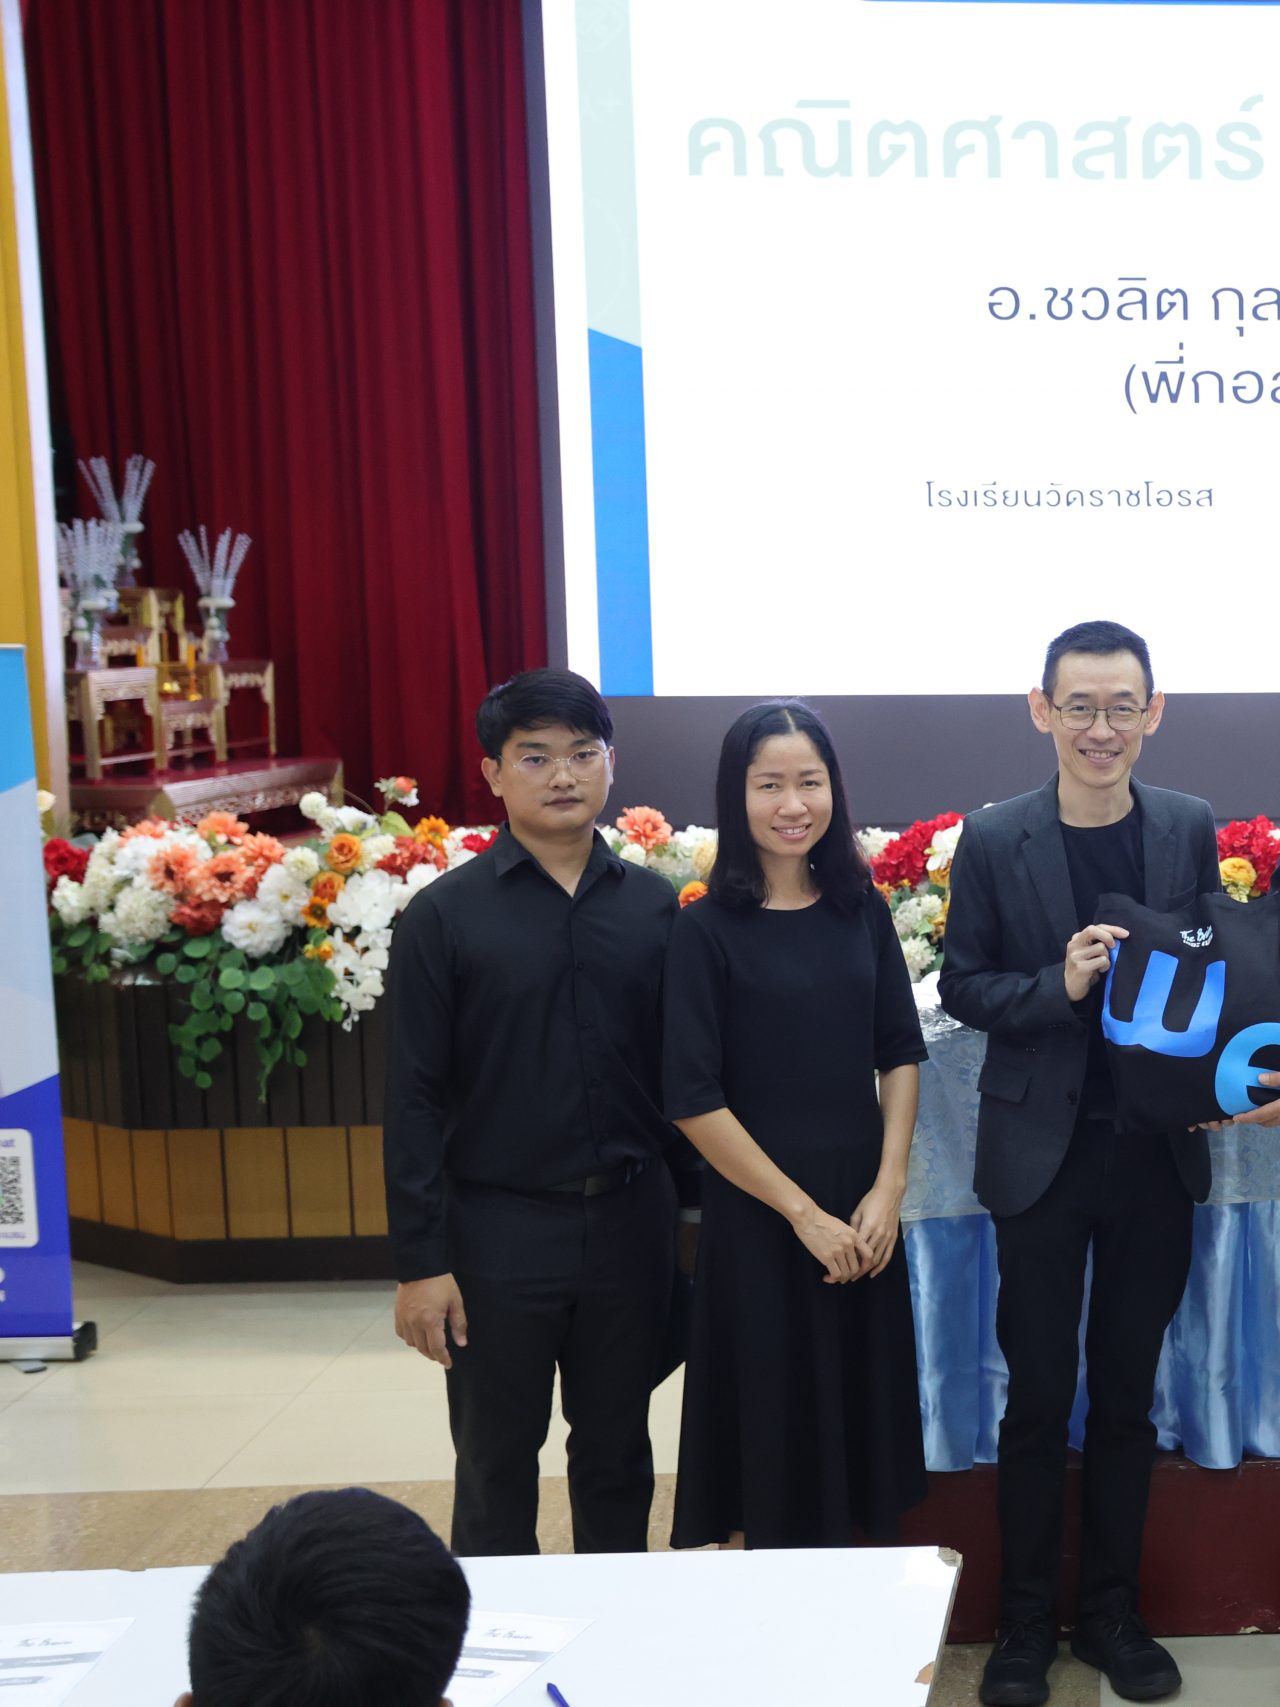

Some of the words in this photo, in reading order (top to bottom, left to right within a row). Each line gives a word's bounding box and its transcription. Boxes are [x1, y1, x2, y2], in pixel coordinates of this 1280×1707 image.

[688, 94, 1264, 182] คณิตศาสตร์
[987, 277, 1188, 321] อ.ชวลิต
[925, 480, 1213, 508] โรงเรียนวัดราชโอรส
